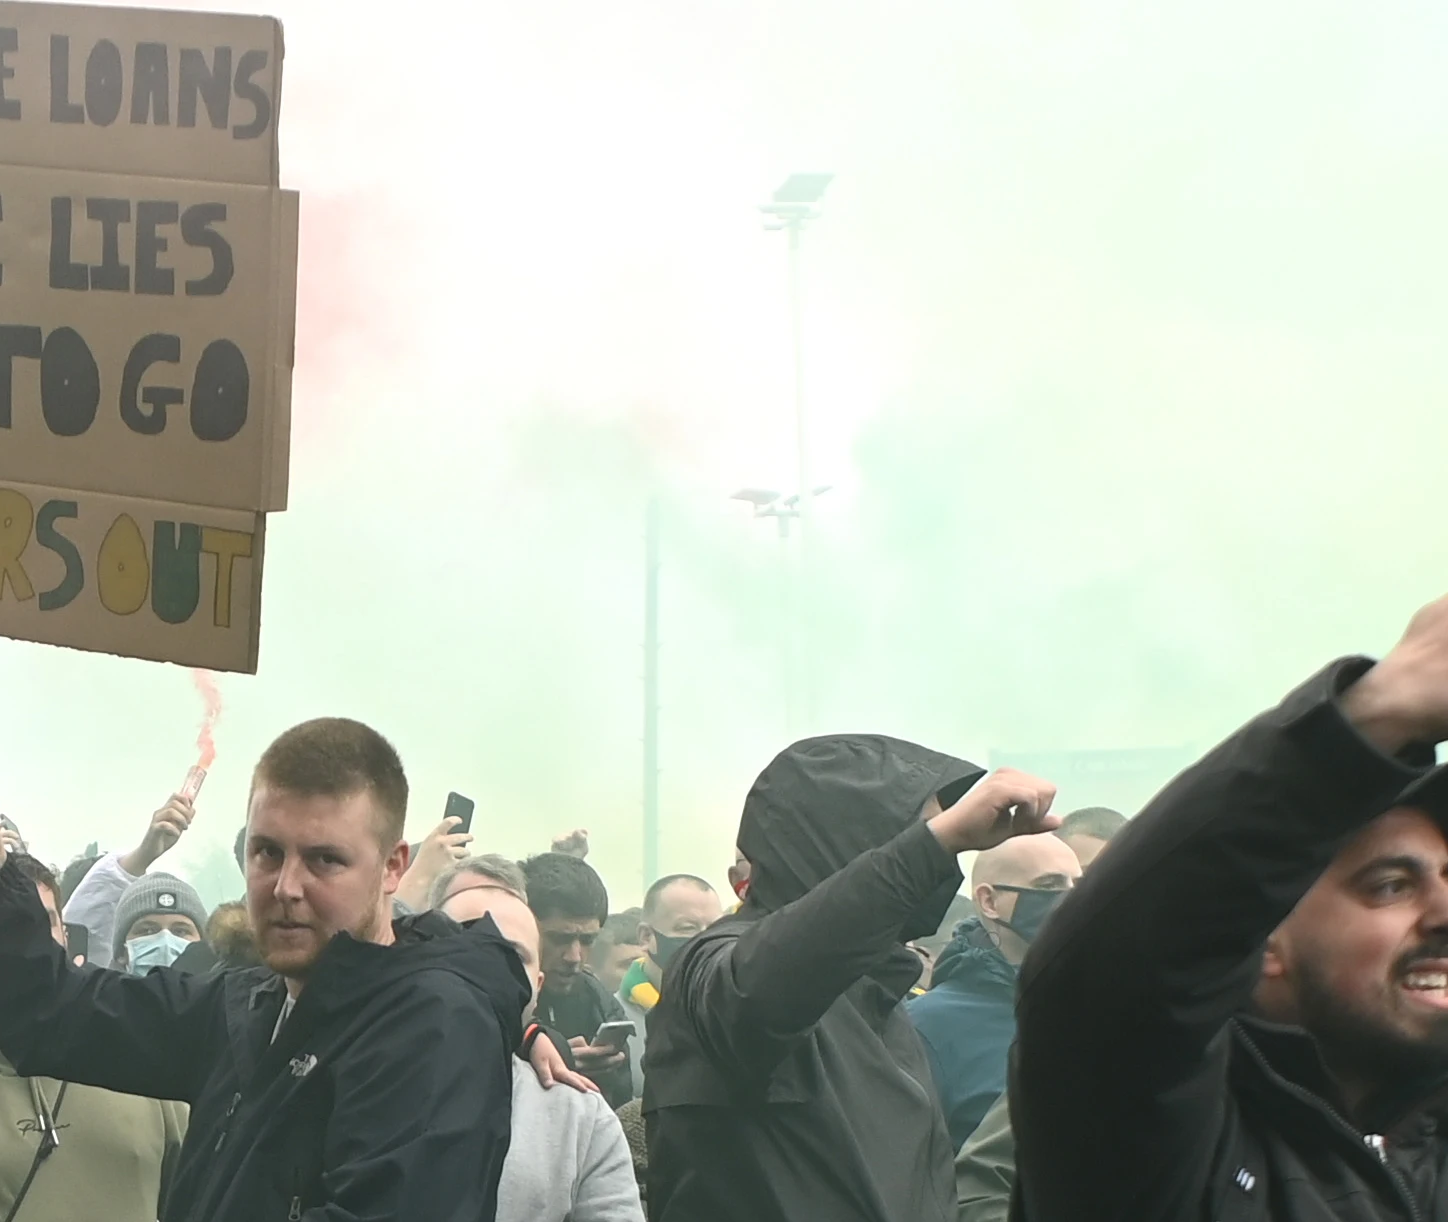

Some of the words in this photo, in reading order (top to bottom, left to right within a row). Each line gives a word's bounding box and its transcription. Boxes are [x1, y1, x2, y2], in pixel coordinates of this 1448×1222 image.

[49, 34, 271, 140] LOANS
[48, 195, 235, 296] LIES
[119, 332, 250, 442] GO
[96, 511, 255, 628] OUT
